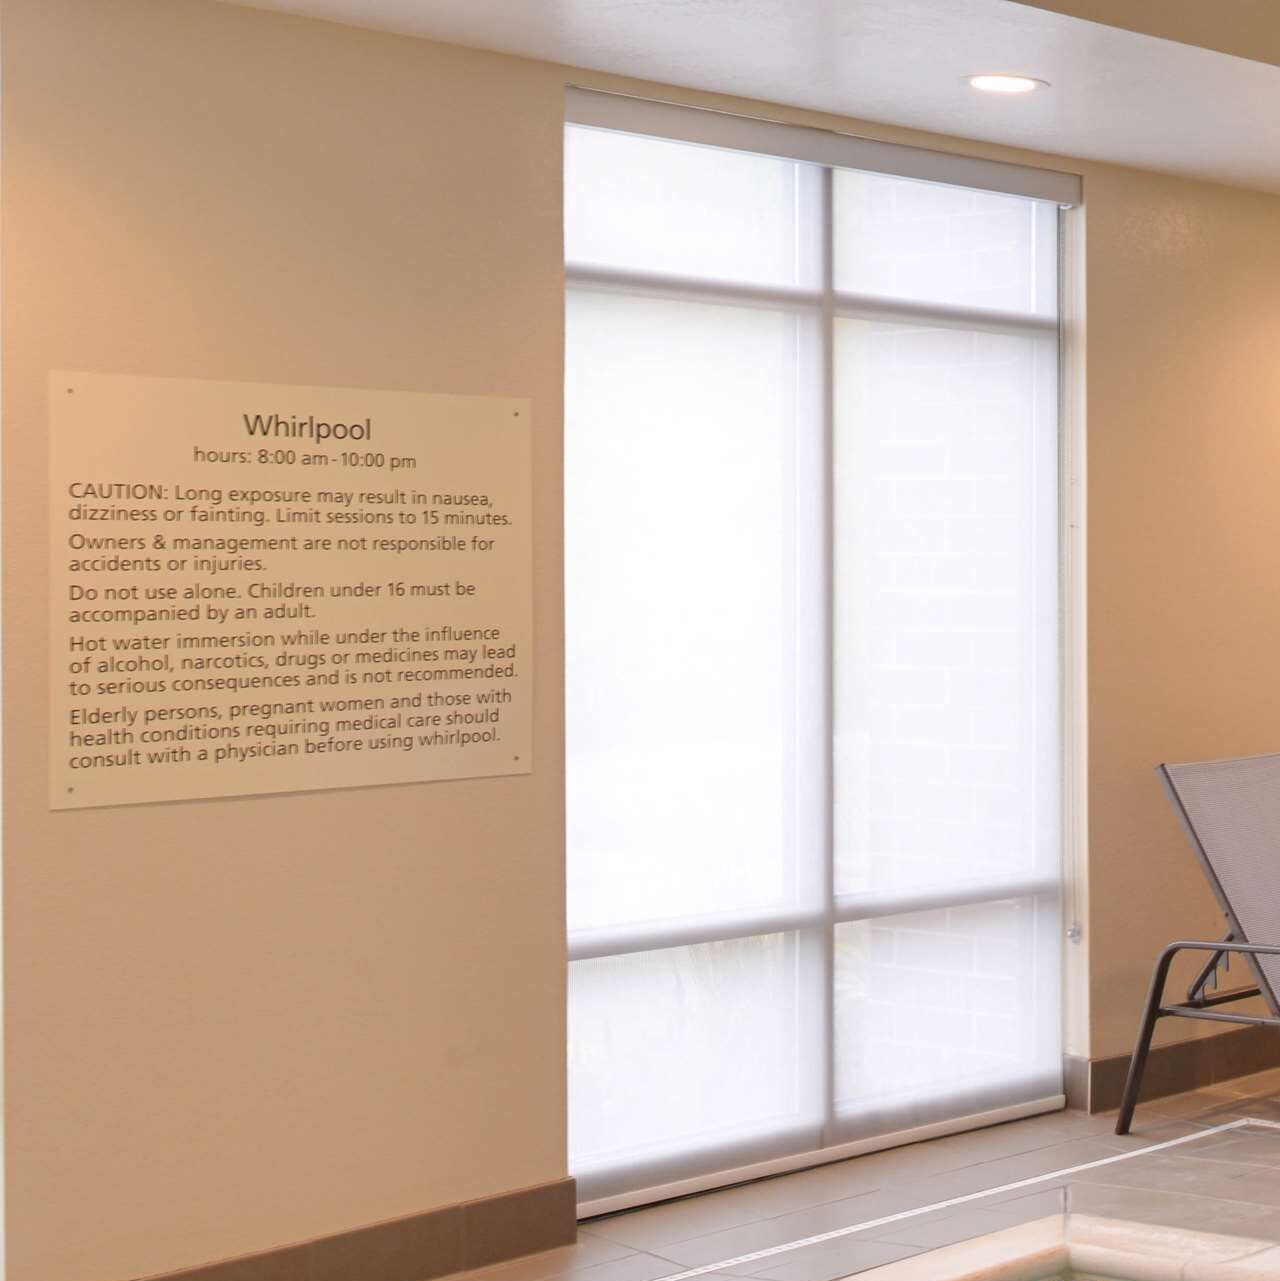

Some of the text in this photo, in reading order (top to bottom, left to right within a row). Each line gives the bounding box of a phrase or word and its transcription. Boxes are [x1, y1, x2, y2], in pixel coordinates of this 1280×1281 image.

[243, 414, 370, 444] Whirlpool
[194, 446, 252, 463] hours:
[258, 449, 296, 464] 8:00
[301, 454, 328, 465] am
[341, 452, 384, 467] 10:00
[390, 457, 416, 472] pm
[69, 483, 492, 508] CAUTION: Long exposure may result in nausea,
[69, 504, 512, 526] dizziness or fainting. Limit sessions to 15 minutes.
[69, 534, 495, 554] Owners & management are not responsible for
[69, 555, 266, 575] accidents or injuries.
[70, 581, 475, 600] Do not use alone. Children under 16 must be
[69, 603, 315, 625] accompanied by an adult.
[70, 626, 500, 652] Hot water immersion while under the influence
[69, 644, 516, 674] of alcohol, narcotics, drugs or medicines may lead
[68, 663, 518, 696] to serious consequences and is not recommended.
[70, 688, 511, 726] Elderly persons, pregnant women and those with
[70, 708, 499, 746] health conditions requiring medical care should
[69, 728, 500, 769] consult with a physician before using whirlpool.
